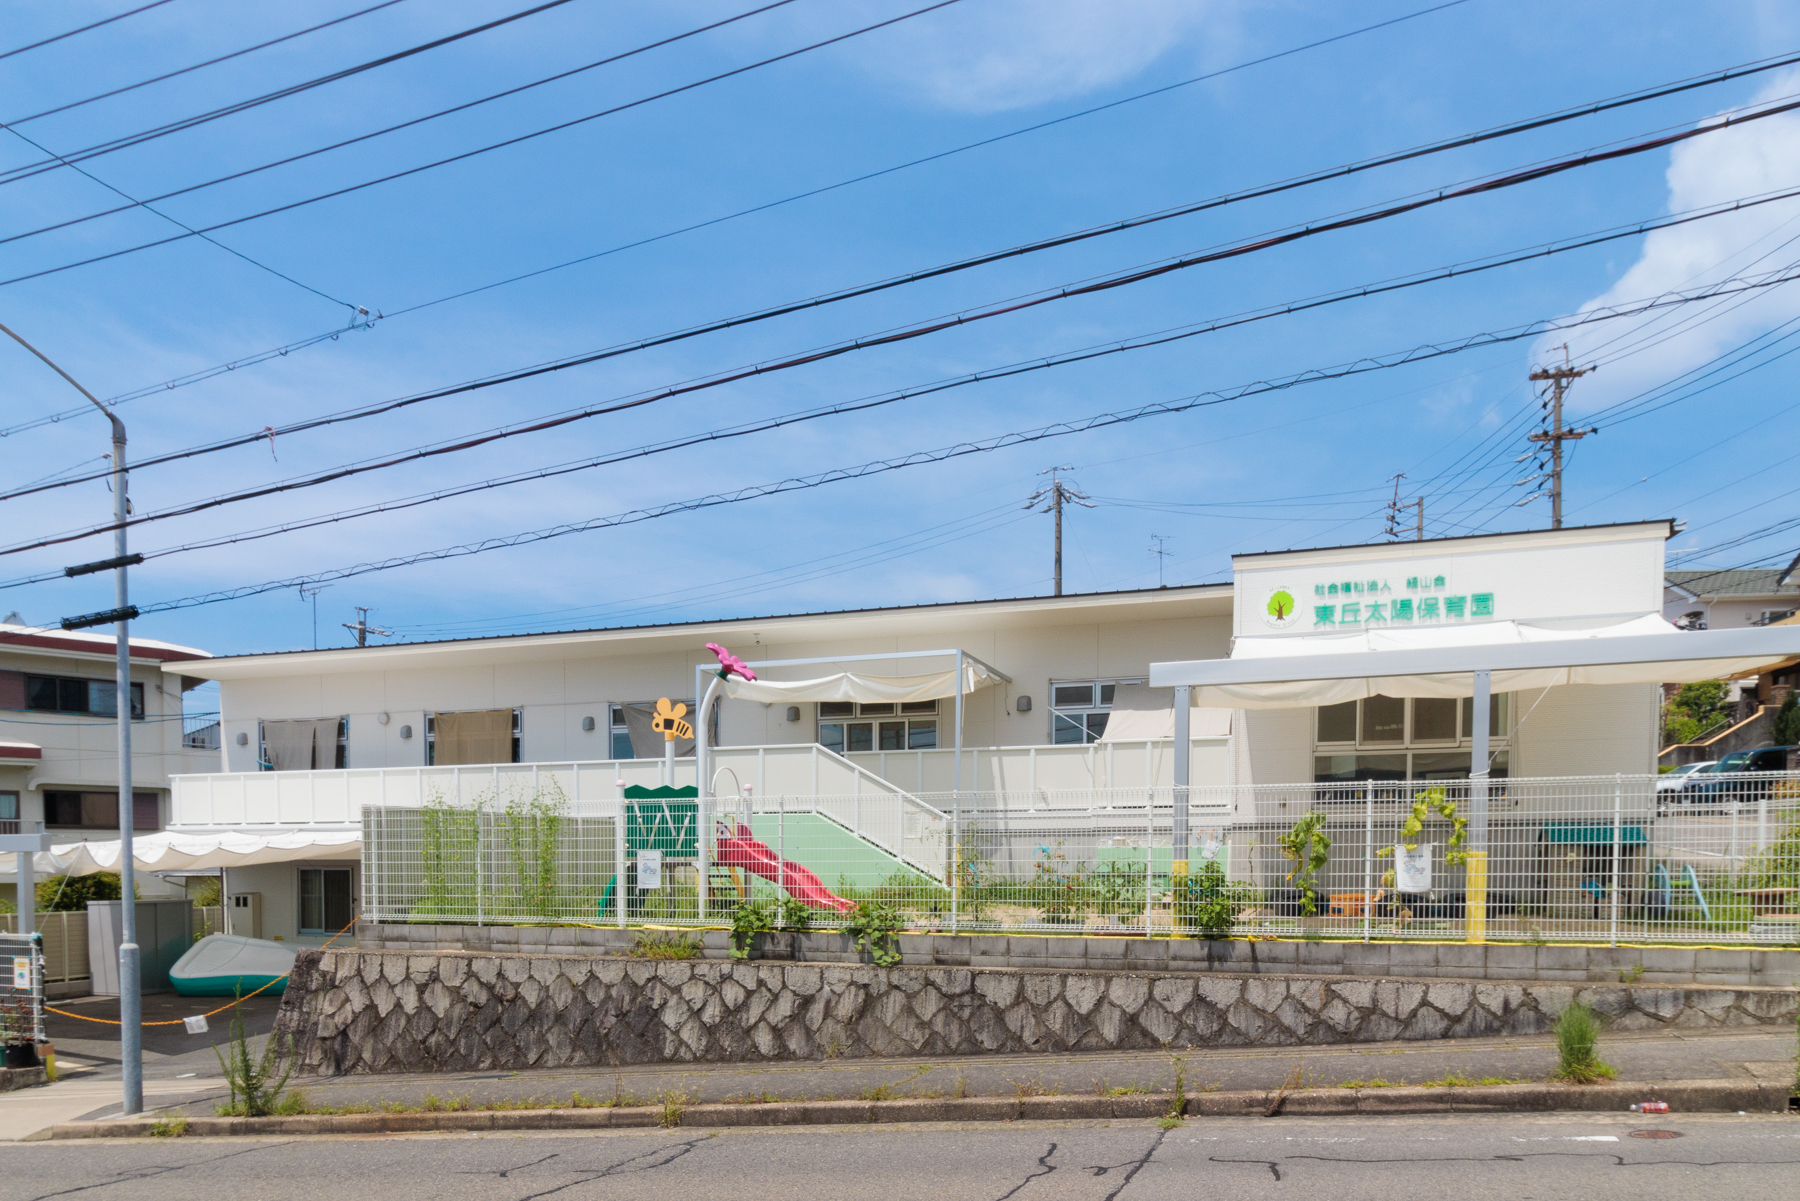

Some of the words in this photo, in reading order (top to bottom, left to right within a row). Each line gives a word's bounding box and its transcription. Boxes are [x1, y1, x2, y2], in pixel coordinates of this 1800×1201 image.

[1314, 579, 1392, 596] 社会福祉法人
[1313, 592, 1494, 626] 東丘太陽保育園
